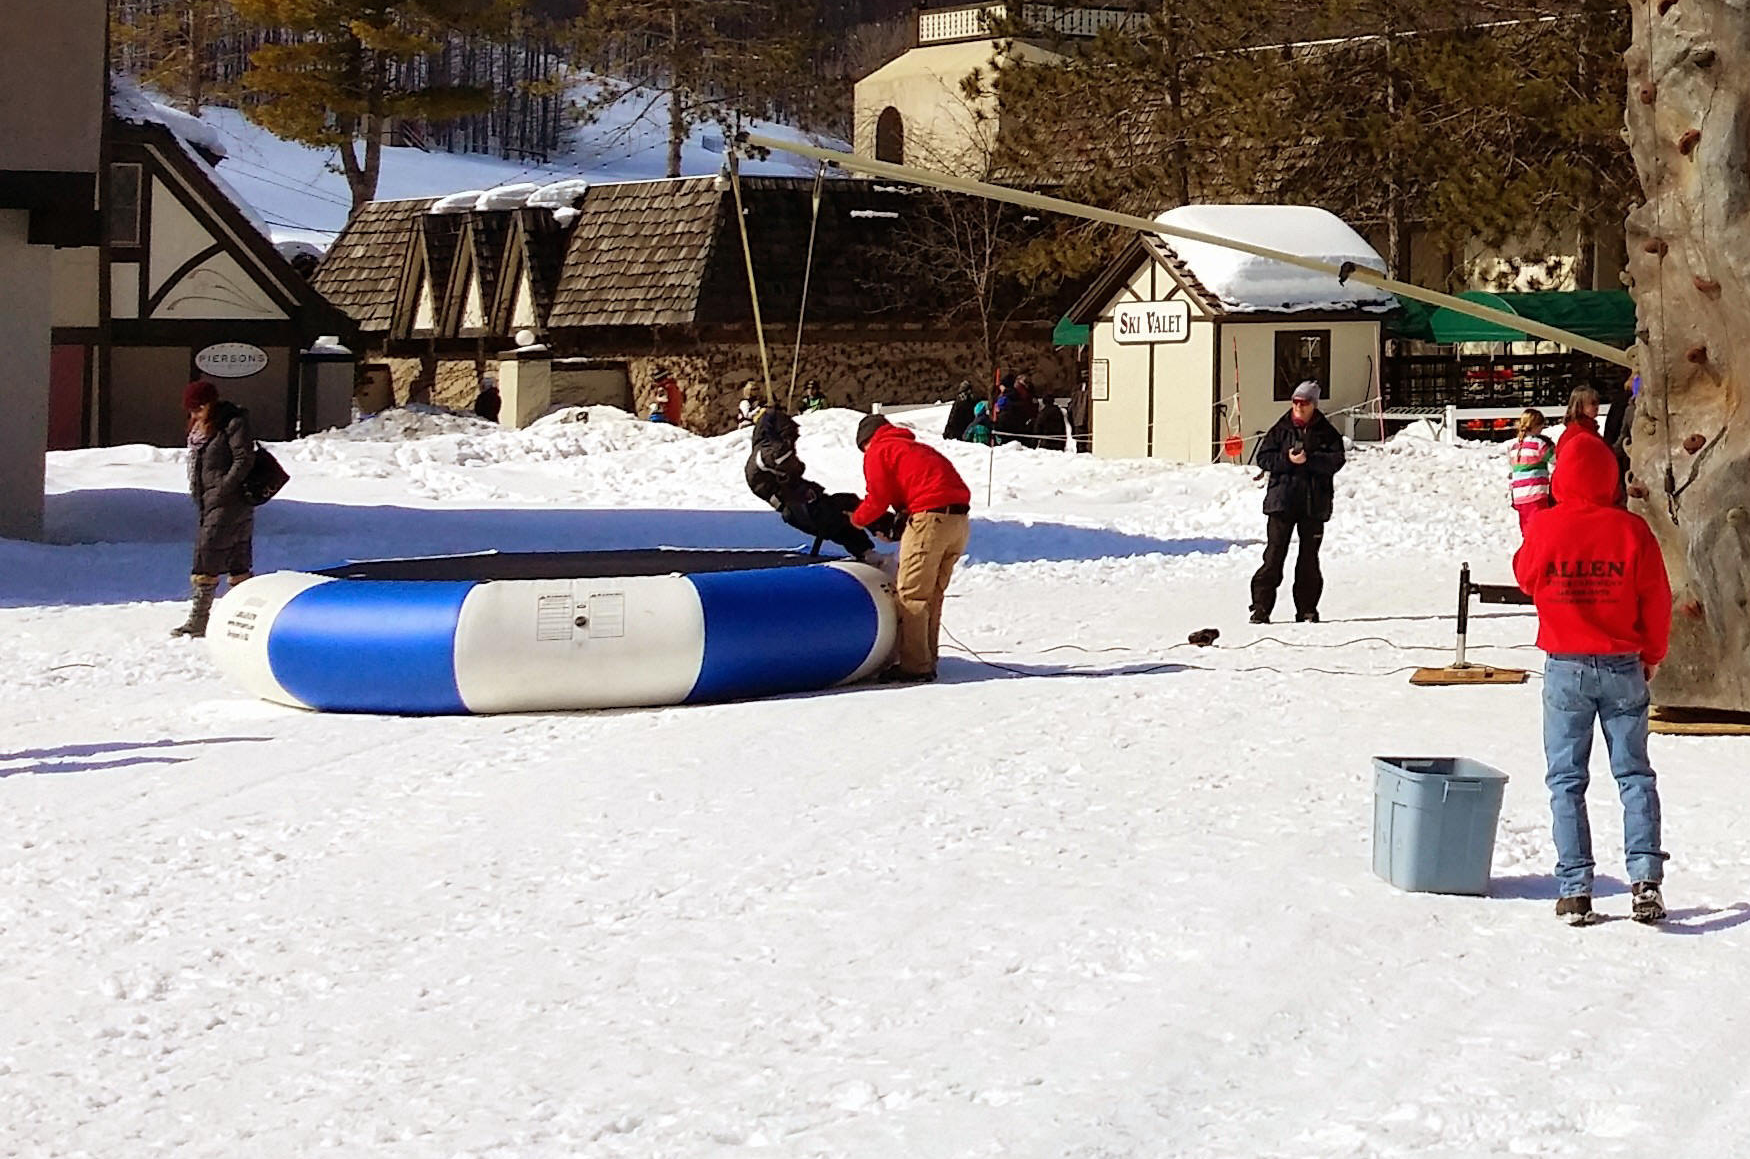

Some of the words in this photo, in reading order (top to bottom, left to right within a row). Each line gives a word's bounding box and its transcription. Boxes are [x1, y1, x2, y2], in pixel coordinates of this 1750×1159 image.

[1120, 312, 1141, 335] SKI
[1146, 311, 1182, 334] VALET
[199, 354, 265, 363] PIERSONS
[1545, 560, 1625, 578] ALLEN
